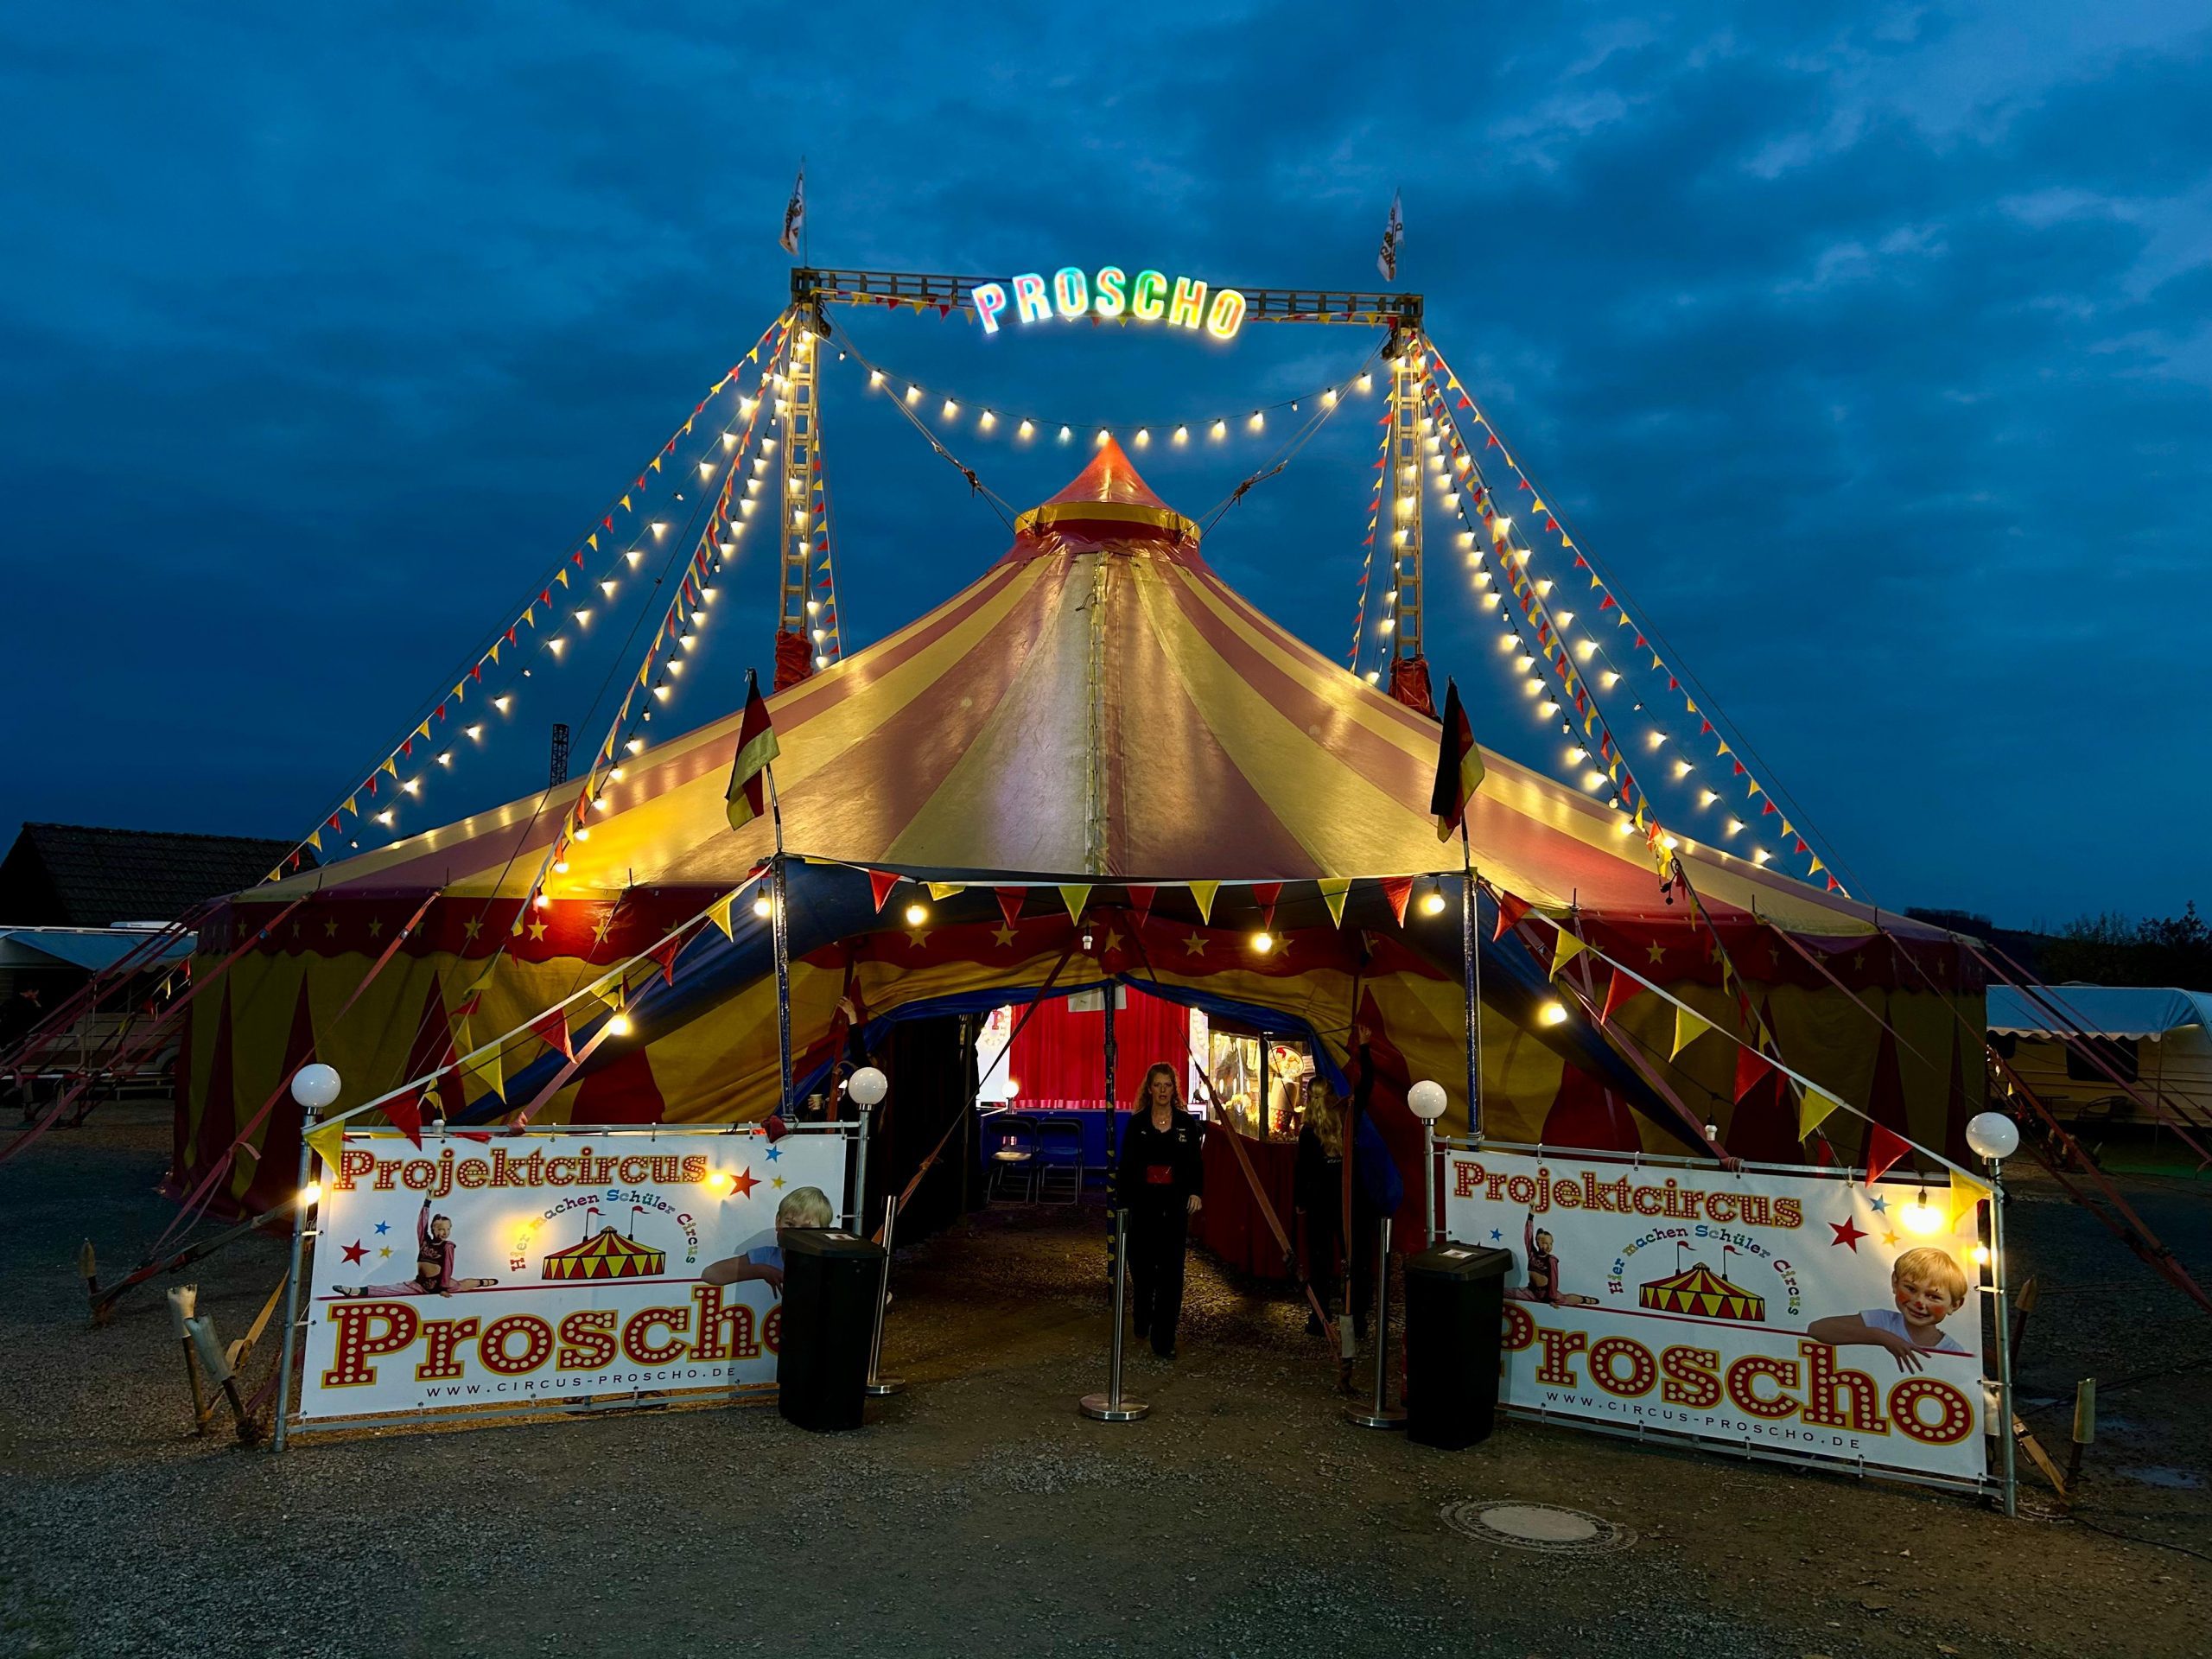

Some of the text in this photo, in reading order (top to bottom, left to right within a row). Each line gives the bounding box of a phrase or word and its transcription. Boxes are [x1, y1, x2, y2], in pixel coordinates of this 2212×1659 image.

[971, 266, 1247, 340] PROSCHO
[331, 1146, 709, 1198] Projektcircus
[1452, 1159, 1804, 1230] Projektcircus
[509, 1189, 699, 1272] Hier machen Schüler Circus
[1607, 1224, 1802, 1317] Hier machen Schüler Circus
[321, 1284, 782, 1389] Prosch
[426, 1367, 735, 1398] WWW.CIRCUS-PROSCHO.DE
[1546, 1390, 1861, 1451] WWW.CIRCUS-PROSCHO.DE
